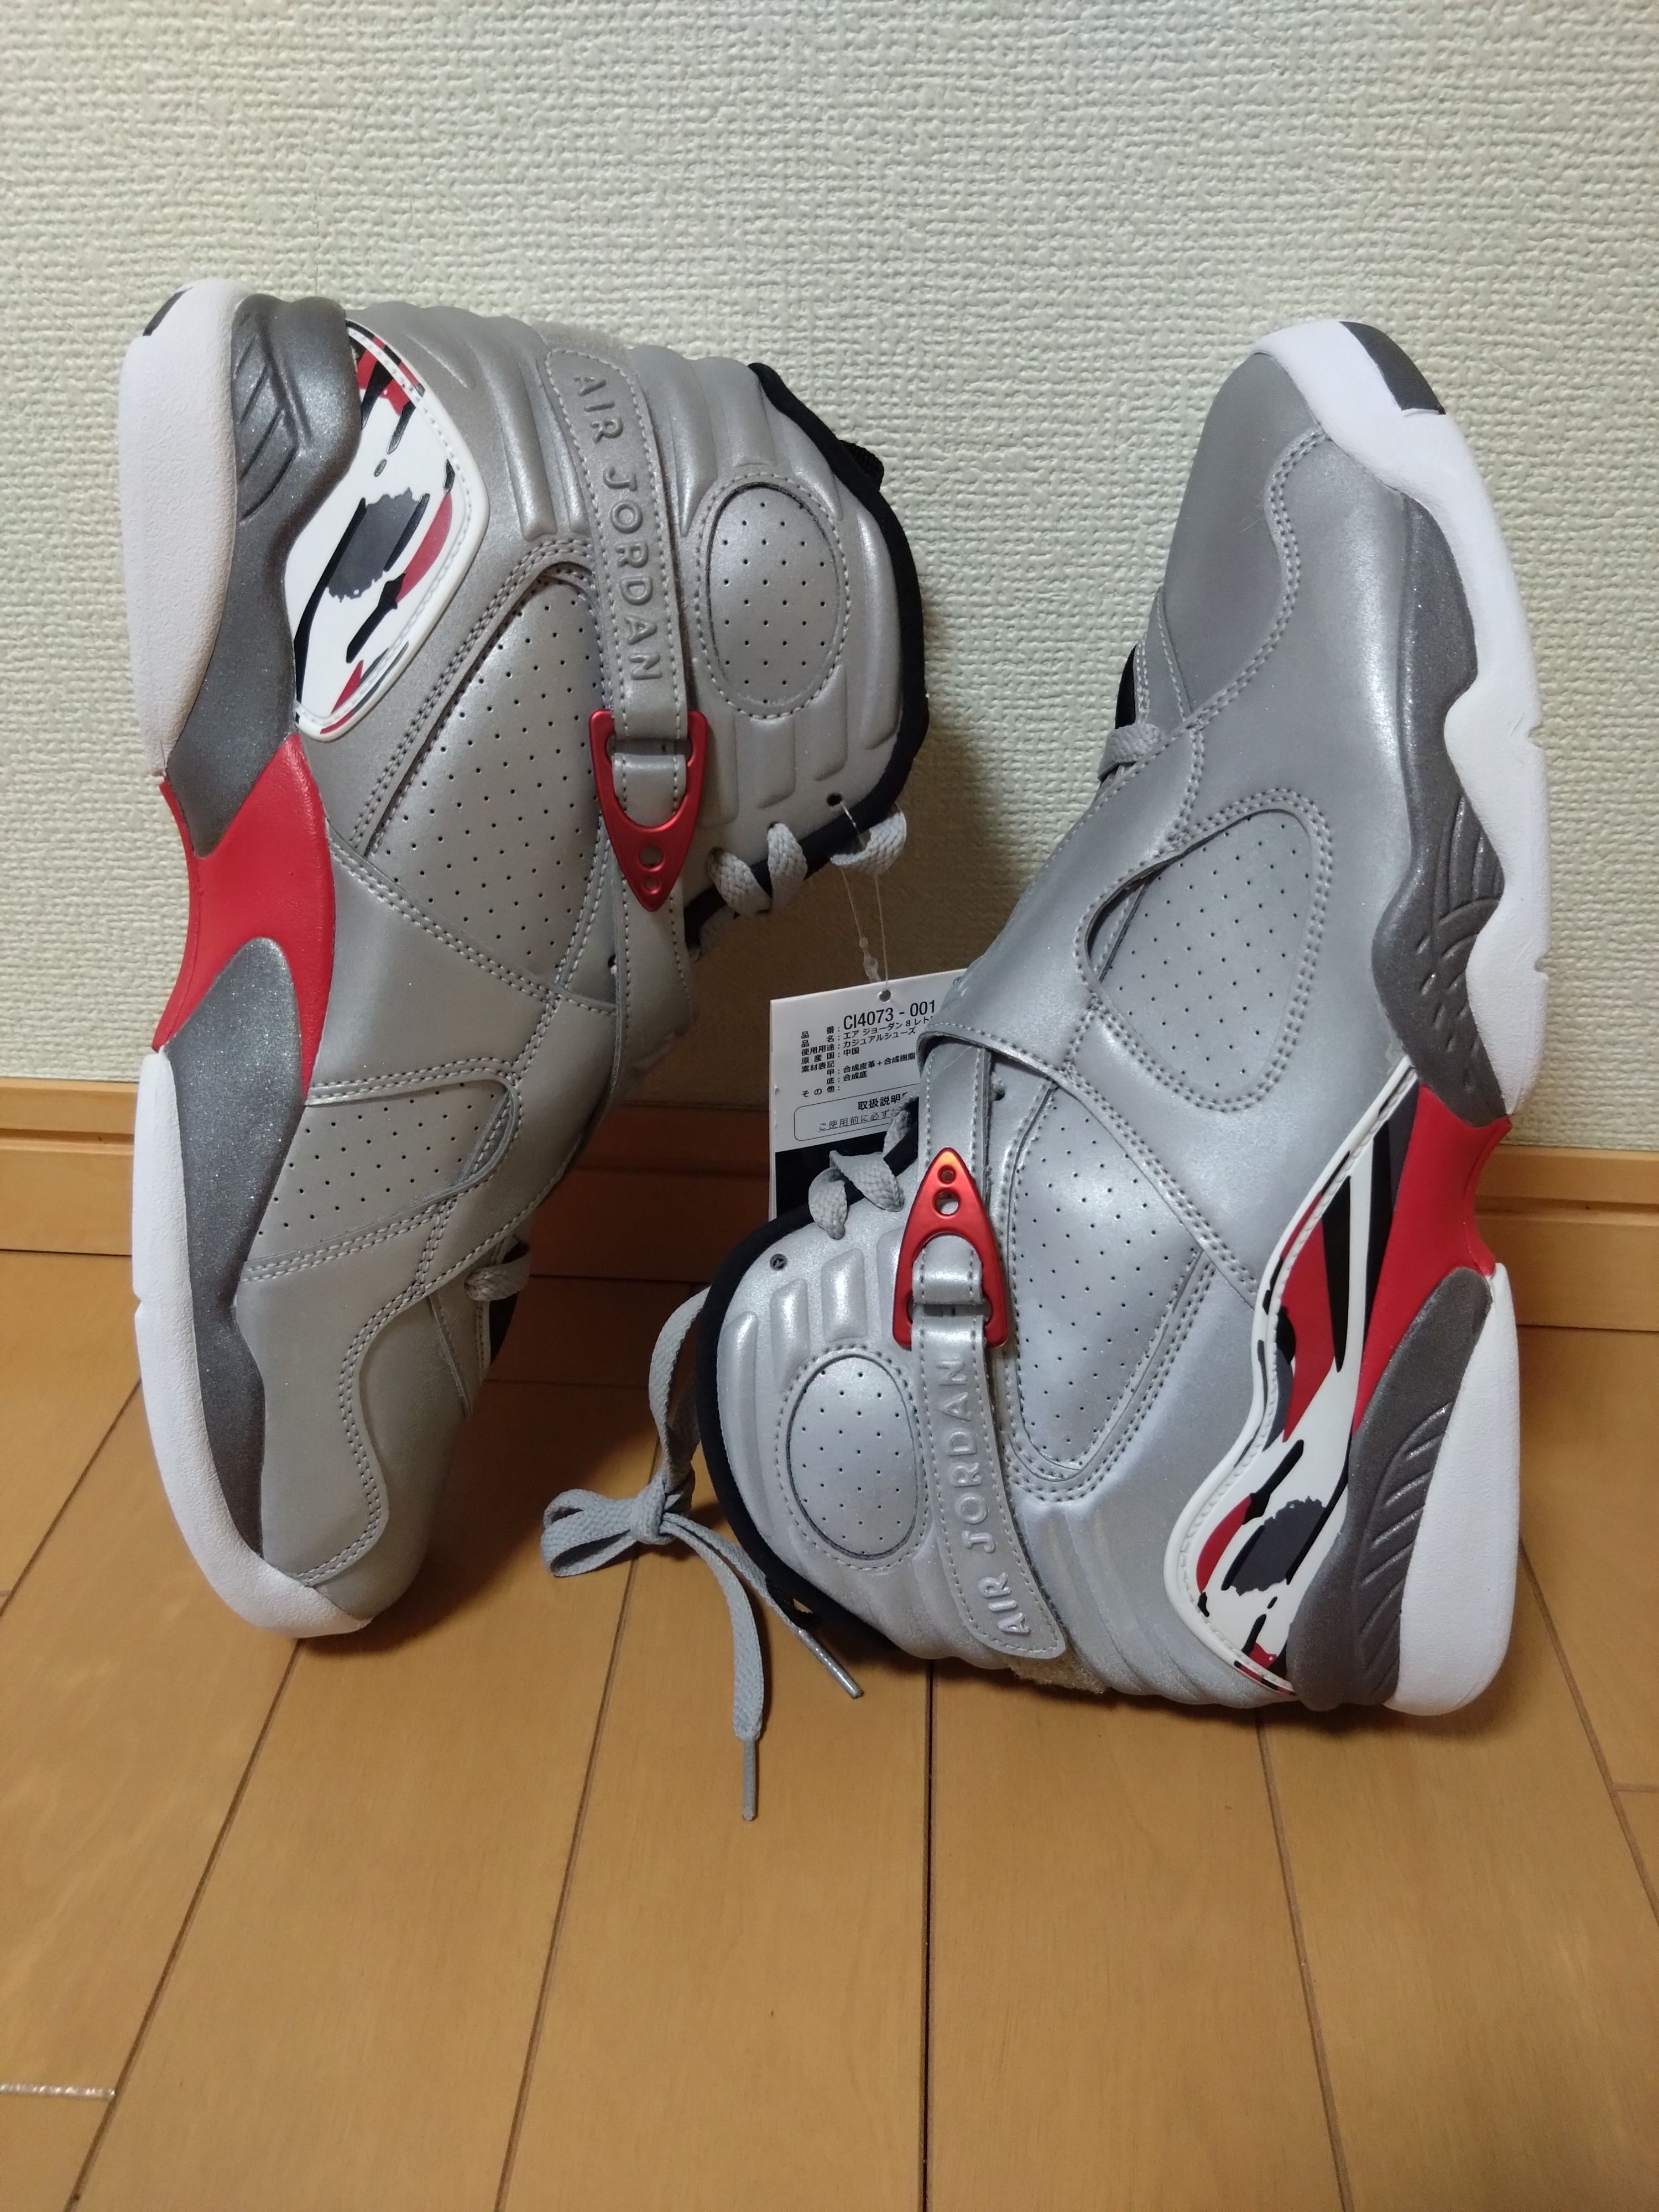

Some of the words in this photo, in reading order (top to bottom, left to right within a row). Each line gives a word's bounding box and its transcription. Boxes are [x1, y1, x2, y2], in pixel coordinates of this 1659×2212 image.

[574, 375, 623, 445] AIR
[602, 465, 663, 681] JORDAN
[843, 1007, 894, 1030] CI4073
[910, 999, 935, 1017] 001
[914, 1015, 933, 1025] レト
[843, 1047, 859, 1056] 中国
[857, 1092, 907, 1110] 取扱説明
[936, 1355, 997, 1554] JORDAN
[978, 1571, 1031, 1635] AIR
